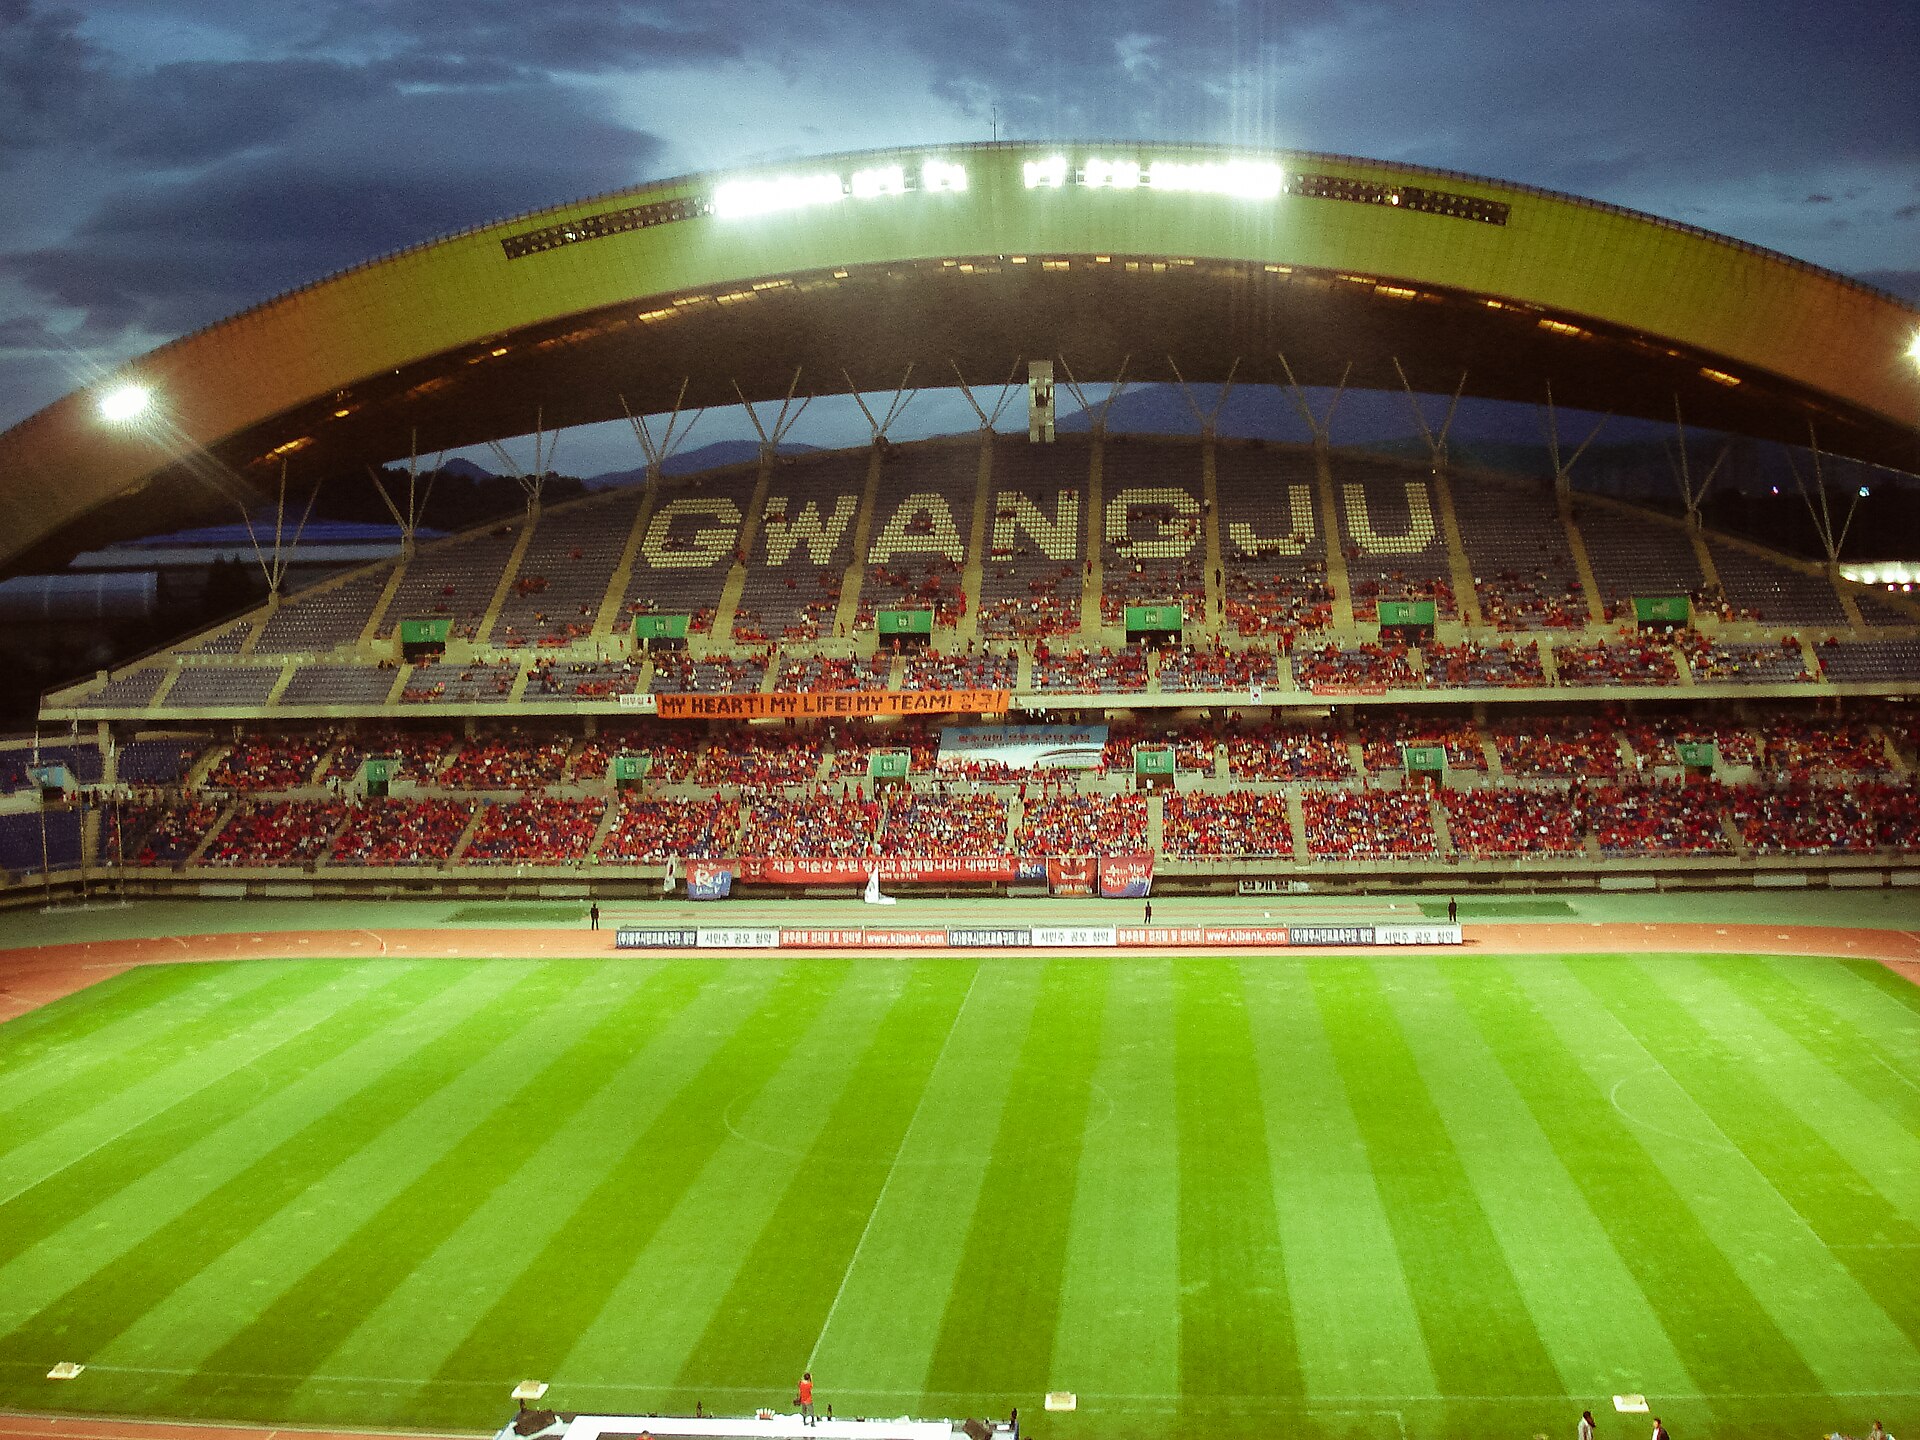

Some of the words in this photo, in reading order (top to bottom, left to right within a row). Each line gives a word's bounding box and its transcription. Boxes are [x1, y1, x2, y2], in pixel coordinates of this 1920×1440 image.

[640, 482, 1435, 568] GWANGJU
[661, 697, 686, 714] MY
[770, 696, 797, 713] MY
[803, 696, 852, 713] LIFE!
[857, 695, 883, 712] MY
[772, 860, 795, 874] 지금
[798, 860, 833, 873] 이순간
[705, 932, 729, 945] 시민주
[734, 932, 750, 945] 공모
[866, 932, 945, 945] www.kjbank.com
[1040, 931, 1065, 943] 시민주
[1071, 931, 1087, 943] 공모
[1205, 929, 1286, 943] www.kjbank.com
[1384, 930, 1410, 944] 시민주
[1415, 930, 1431, 944] 공모
